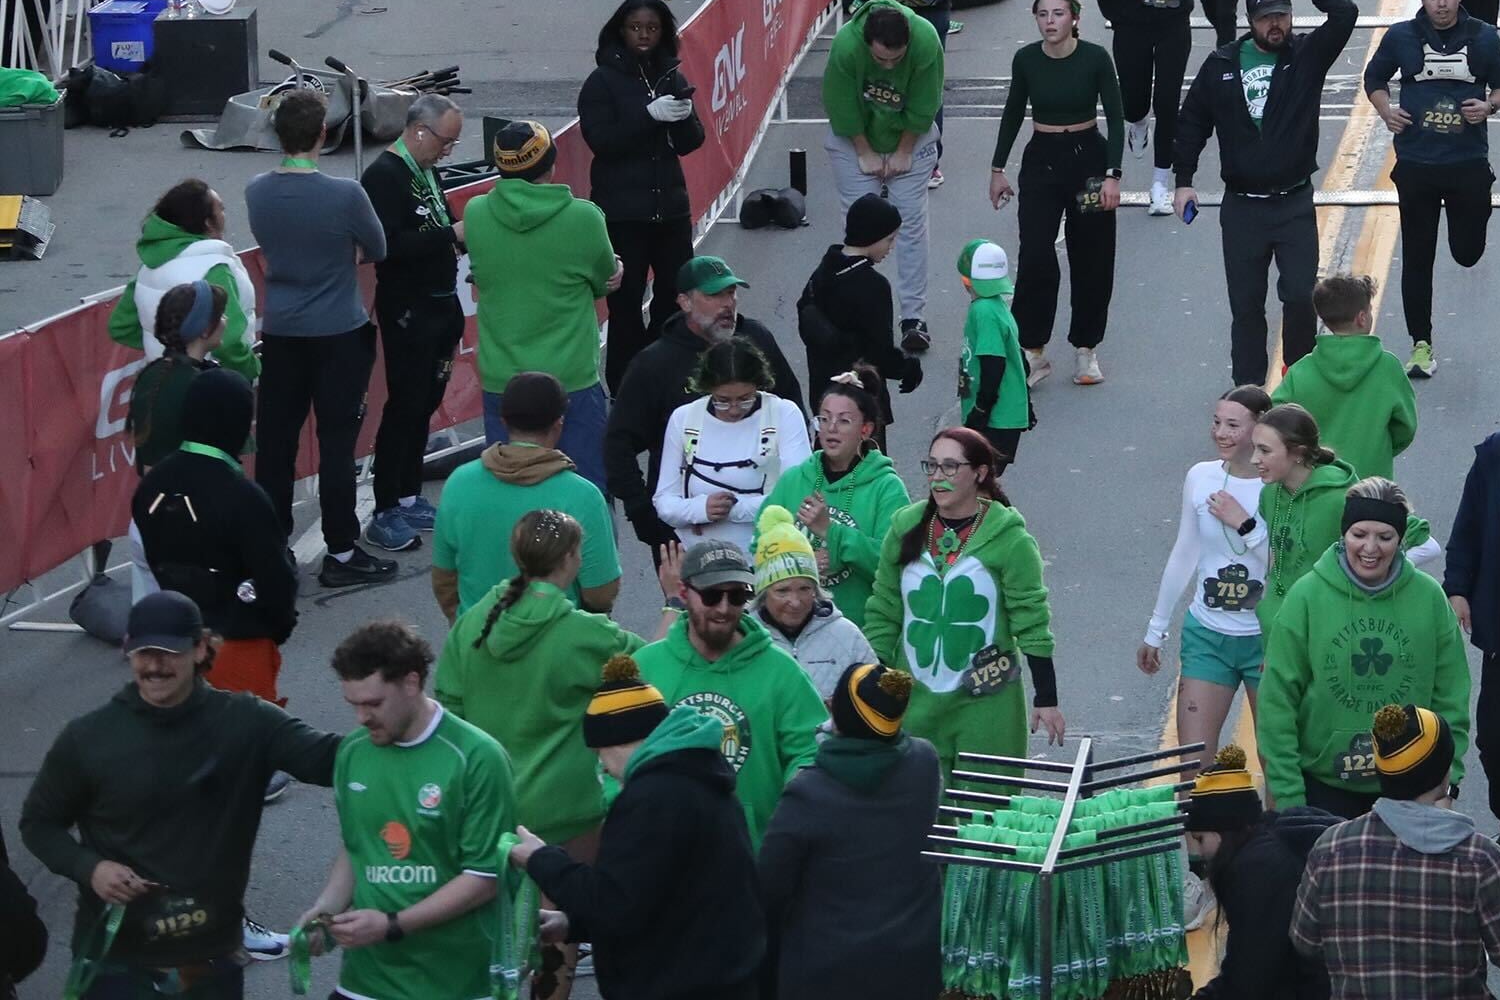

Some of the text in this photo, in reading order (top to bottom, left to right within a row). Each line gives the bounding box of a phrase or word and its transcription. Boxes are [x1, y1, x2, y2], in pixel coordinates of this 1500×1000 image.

[712, 21, 747, 113] GNC
[868, 85, 900, 102] 2106
[1424, 111, 1462, 125] 2202
[1083, 191, 1100, 205] 19
[92, 441, 137, 481] LIV
[1216, 581, 1249, 598] 719
[1332, 618, 1410, 650] PITTSBURGH
[970, 656, 1010, 687] 1750
[675, 693, 745, 721] TTSBURGH
[1327, 676, 1414, 714] PARADE DAY DASH
[733, 746, 749, 772] ASH
[1342, 754, 1376, 772] 122
[155, 909, 207, 934] 1129
